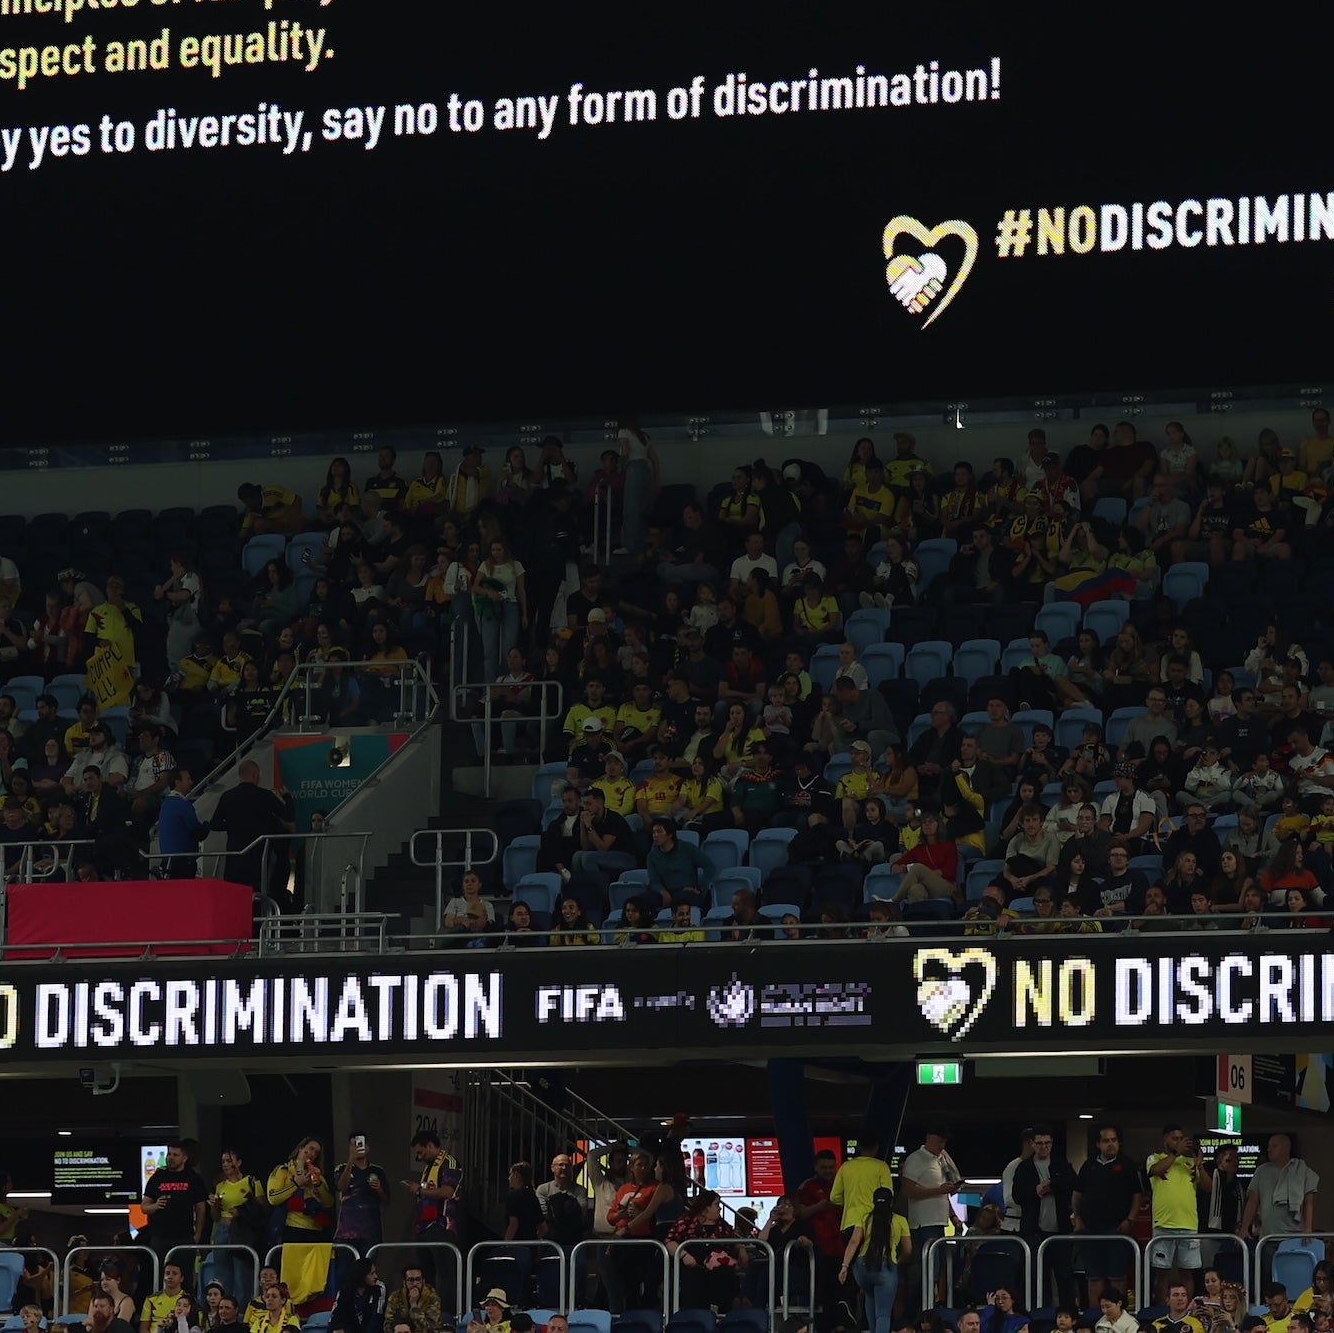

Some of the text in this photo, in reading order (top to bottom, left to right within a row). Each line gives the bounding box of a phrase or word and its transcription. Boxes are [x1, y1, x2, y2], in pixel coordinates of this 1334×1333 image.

[105, 28, 169, 72] and
[179, 20, 334, 78] equality.
[28, 124, 91, 170] yes
[99, 115, 135, 153] to
[145, 102, 313, 155] diversity,
[322, 106, 386, 150] say
[394, 103, 438, 136] no
[447, 93, 484, 132] to
[493, 95, 559, 139] any
[567, 82, 657, 125] form
[667, 76, 704, 120] of
[713, 57, 1001, 117] discrimination!
[290, 789, 328, 799] WORLD
[300, 780, 323, 789] FIFA
[34, 972, 502, 1048] DISCRIMINATION
[537, 985, 624, 1022] FIFA
[1015, 958, 1096, 1027] NO
[1230, 1065, 1245, 1090] 06
